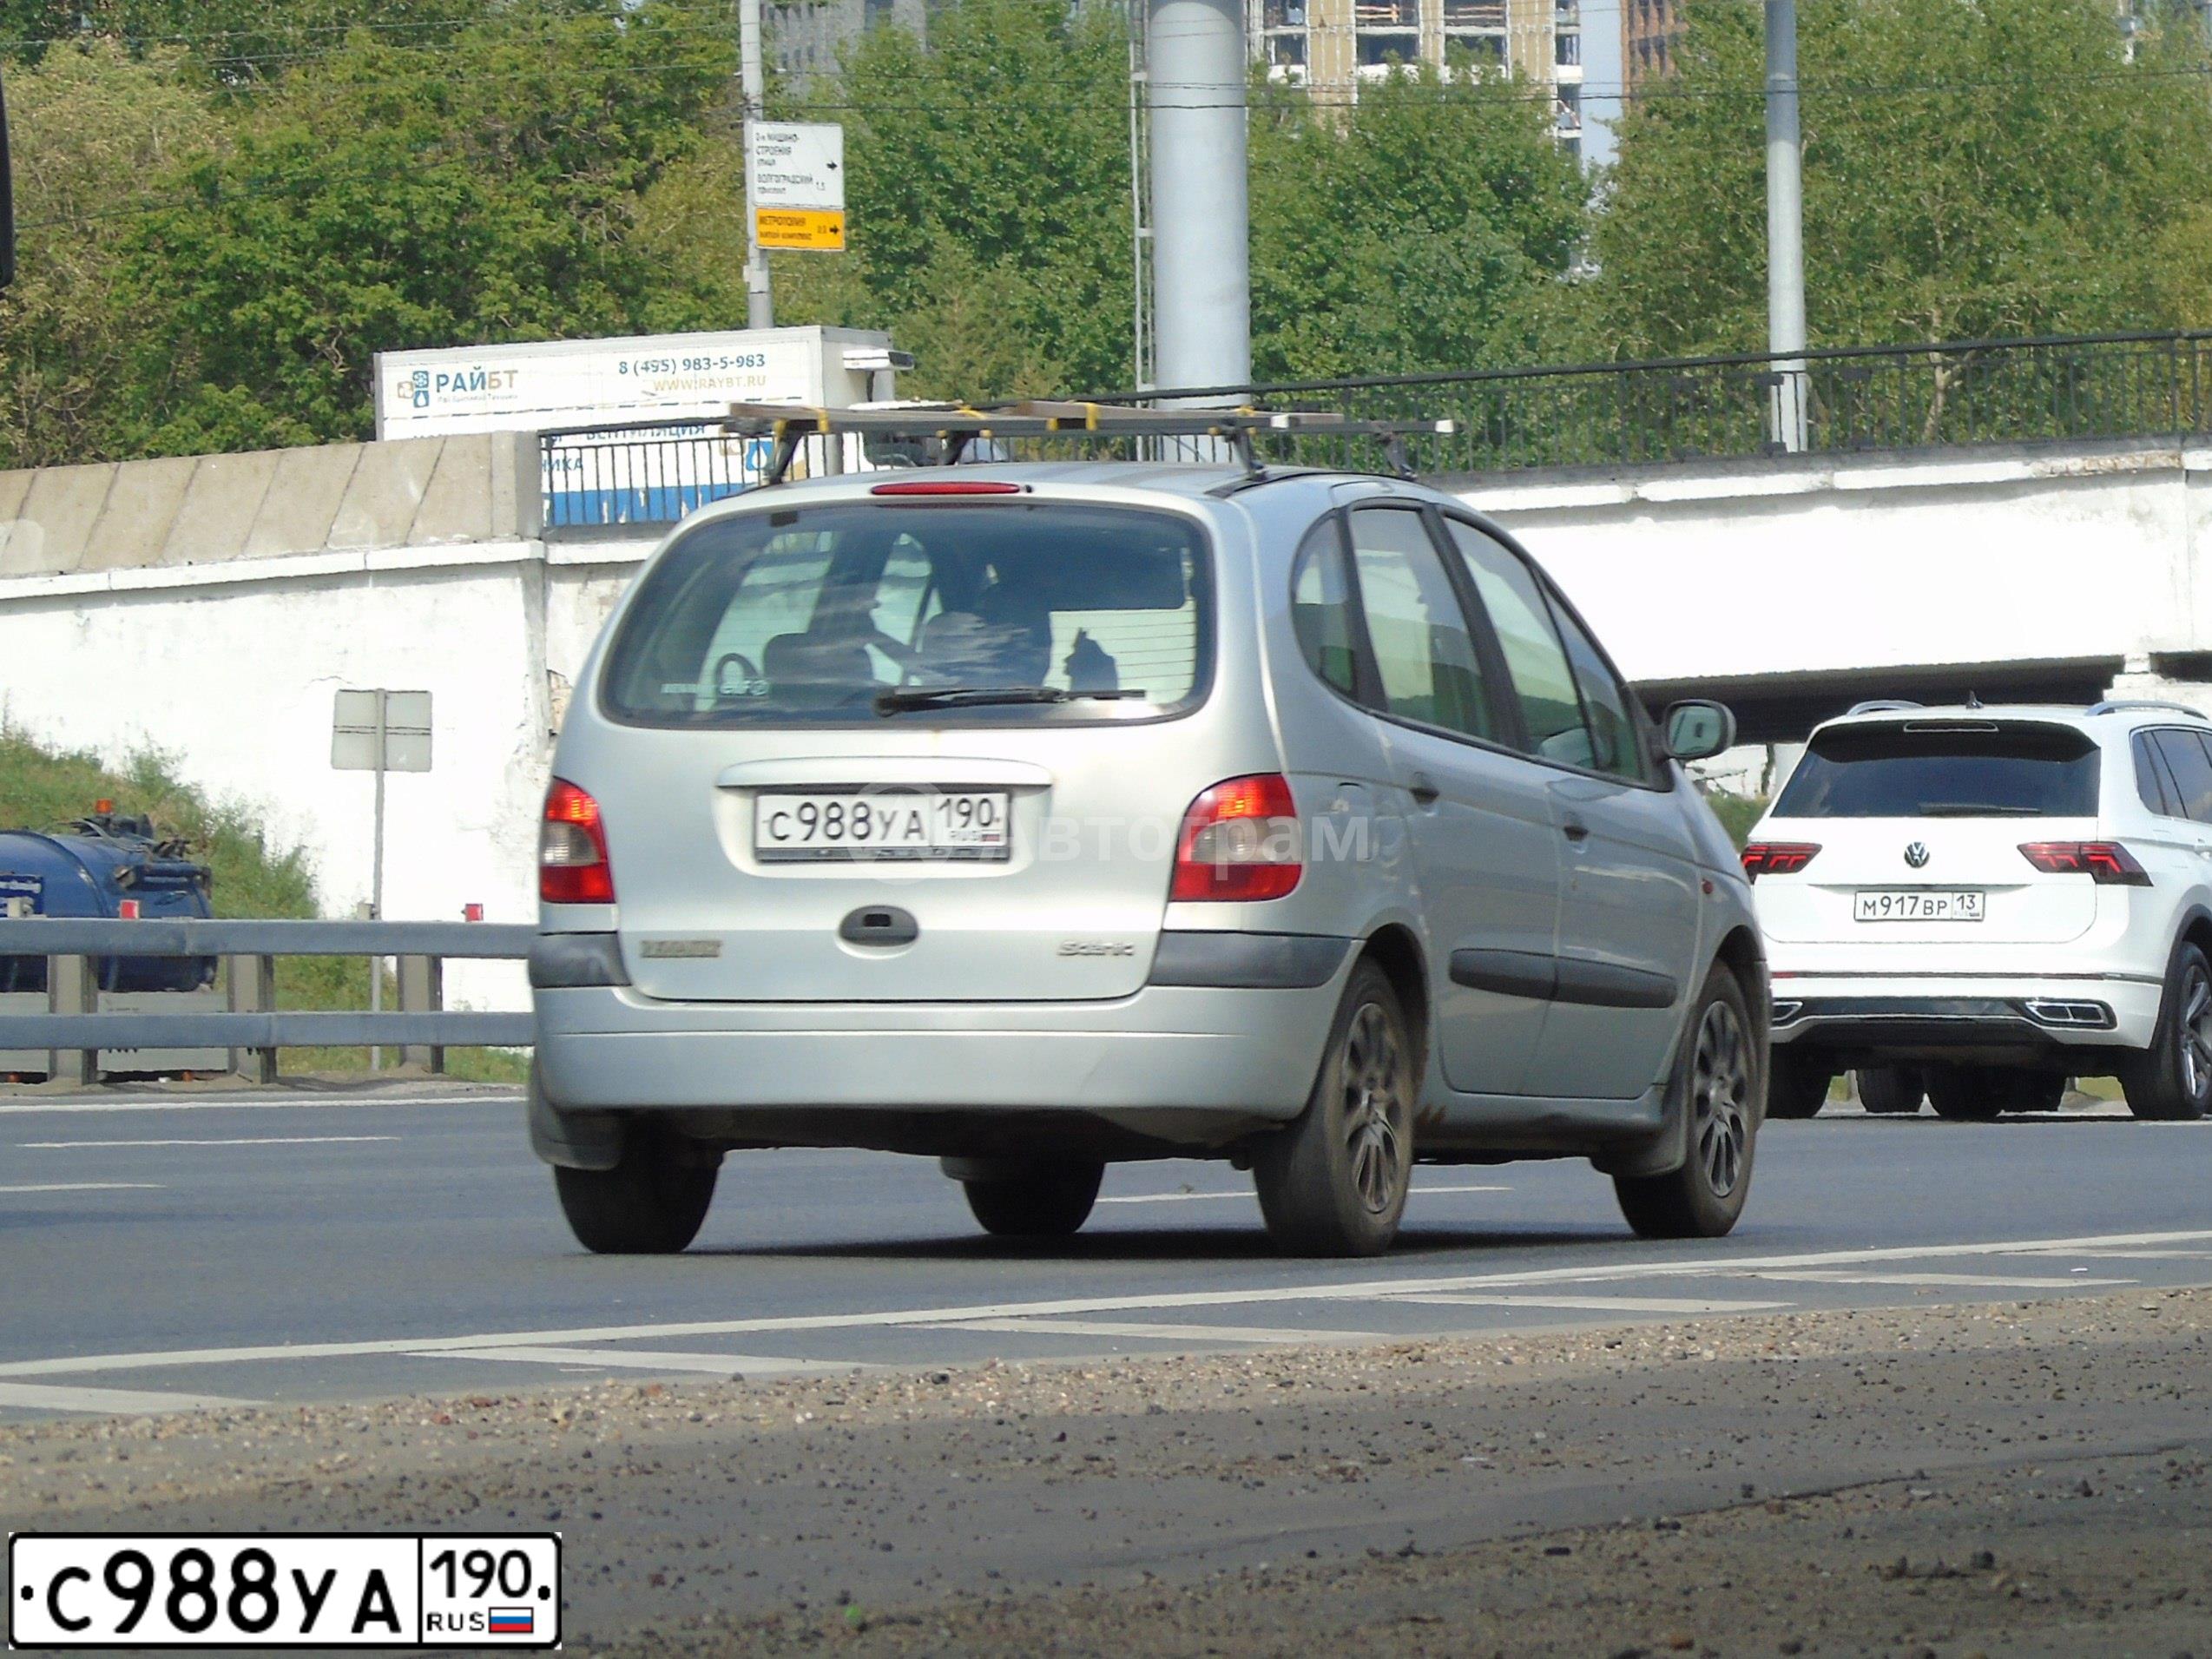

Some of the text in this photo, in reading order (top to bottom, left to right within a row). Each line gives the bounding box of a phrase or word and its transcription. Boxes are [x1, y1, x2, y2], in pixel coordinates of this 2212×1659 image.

[618, 353, 766, 376] 8 (495) 983-5-983
[436, 365, 519, 393] РАЙБТ
[654, 375, 767, 392] WWW.RAYBT.RU
[768, 797, 995, 841] С988УА 190
[1863, 894, 1976, 916] М917ВР 13
